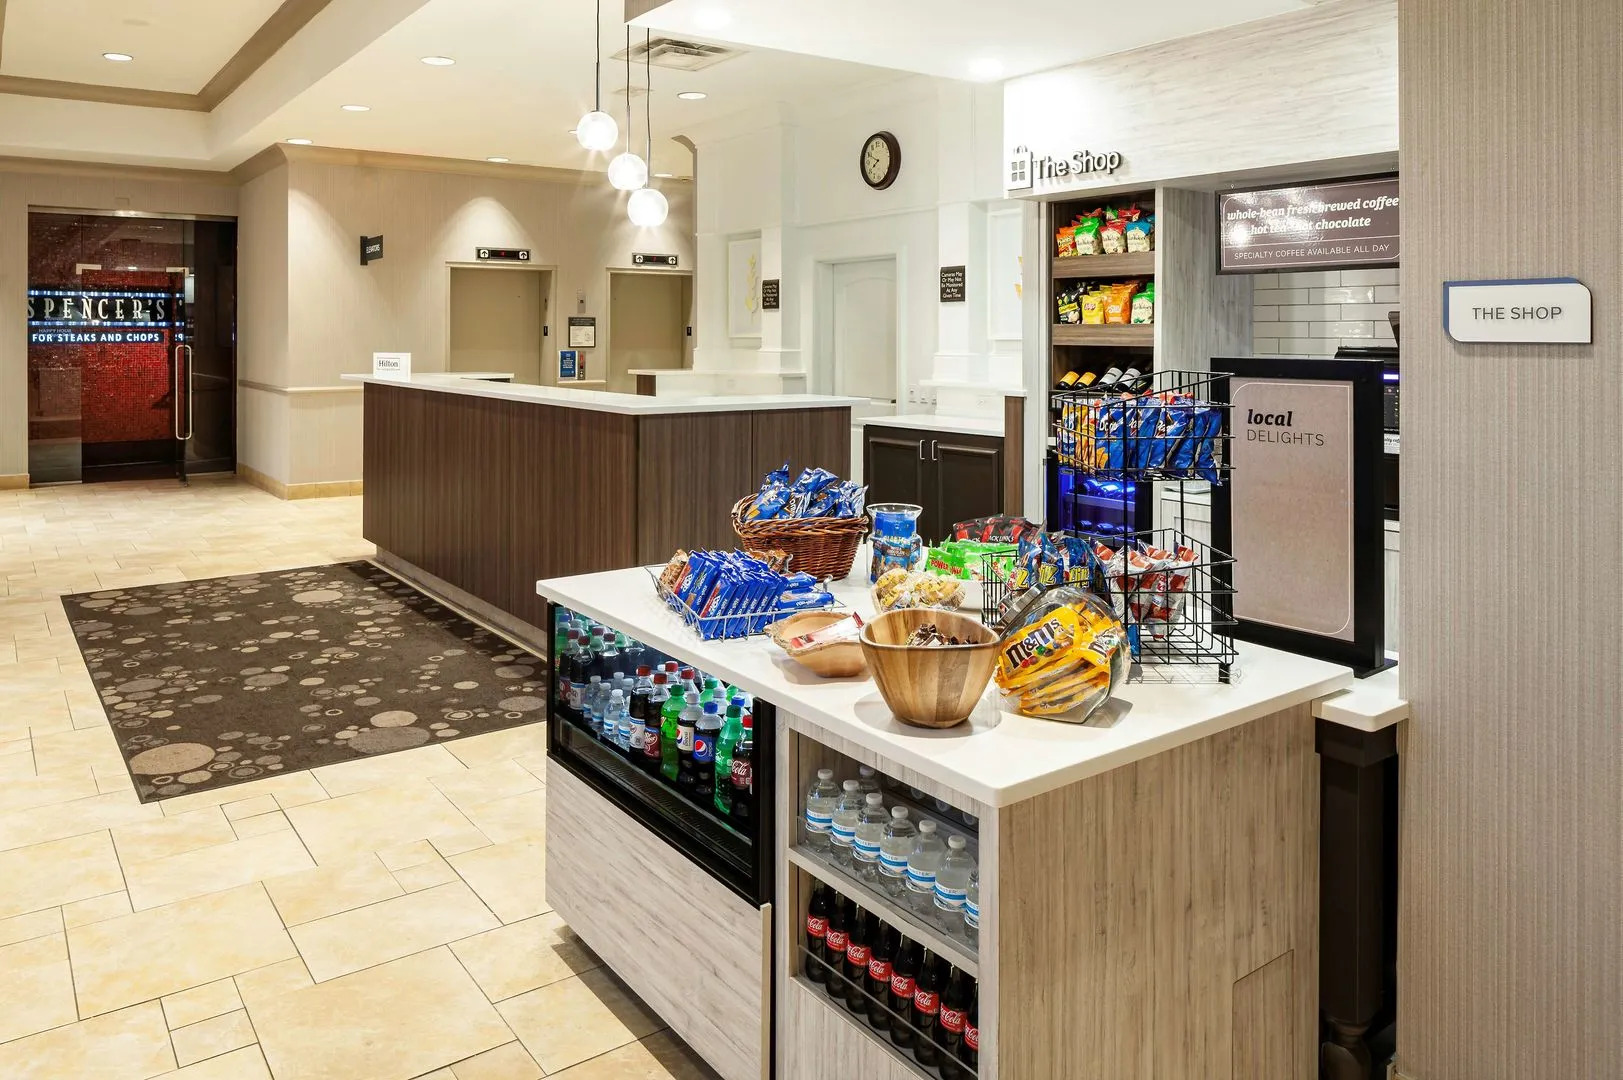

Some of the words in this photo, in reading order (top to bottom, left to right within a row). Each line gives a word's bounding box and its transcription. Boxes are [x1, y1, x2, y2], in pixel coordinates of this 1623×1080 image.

[1032, 155, 1070, 180] The
[1070, 149, 1122, 175] Shop
[1227, 207, 1285, 221] whole-bean
[1362, 195, 1399, 212] coffee
[1315, 216, 1371, 231] chocolate
[366, 244, 380, 254] ELEVATORS
[1234, 250, 1273, 260] SPECIALTY
[1275, 248, 1305, 258] COFFEE
[1307, 246, 1351, 256] AVAILABLE
[1353, 244, 1369, 253] ALL
[1372, 243, 1390, 252] DAY
[1472, 307, 1505, 320] THE
[1510, 306, 1562, 320] SHOP
[32, 333, 53, 342] FOR
[58, 333, 96, 342] STEAKS
[100, 333, 122, 342] AND
[126, 333, 160, 342] CHOPS
[1247, 408, 1293, 427] local
[1247, 429, 1325, 447] DELIGHTS
